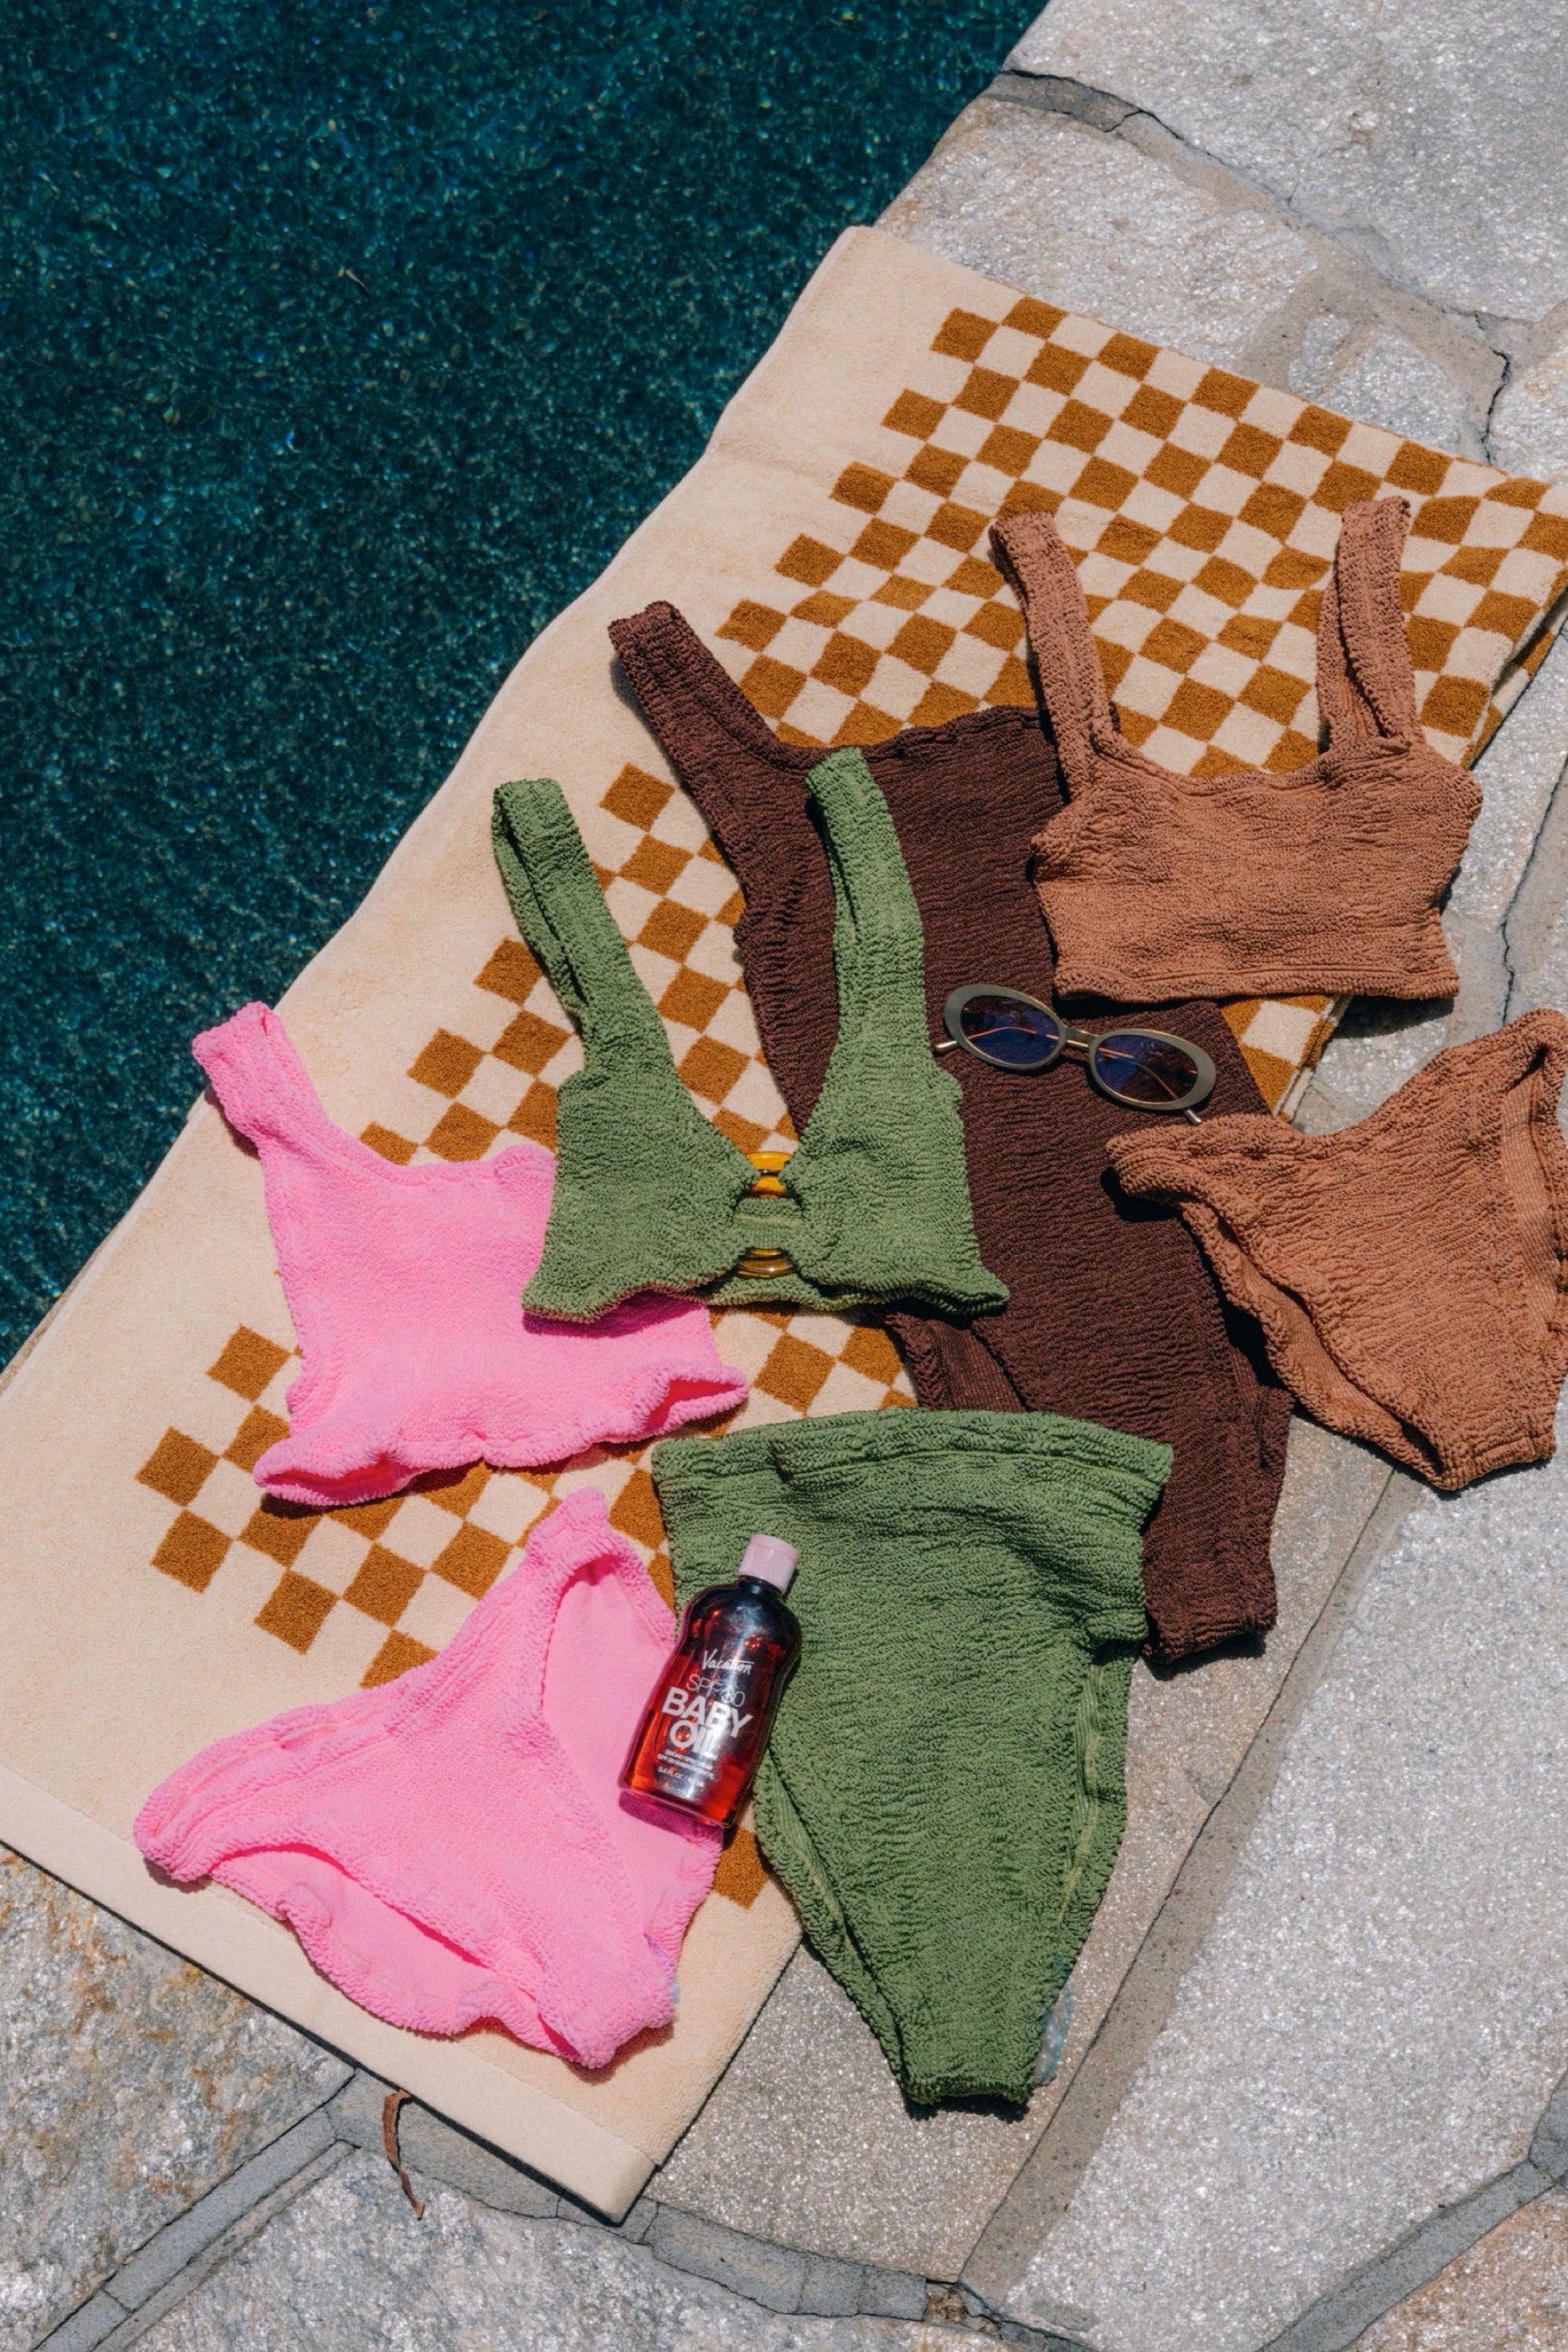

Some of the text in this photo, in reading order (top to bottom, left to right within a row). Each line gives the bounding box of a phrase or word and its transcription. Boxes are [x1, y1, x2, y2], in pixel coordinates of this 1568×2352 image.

[702, 1649, 754, 1674] Vacation
[686, 1674, 746, 1707] SPF 30
[662, 1686, 754, 1739] BABY
[670, 1720, 718, 1760] OIL
